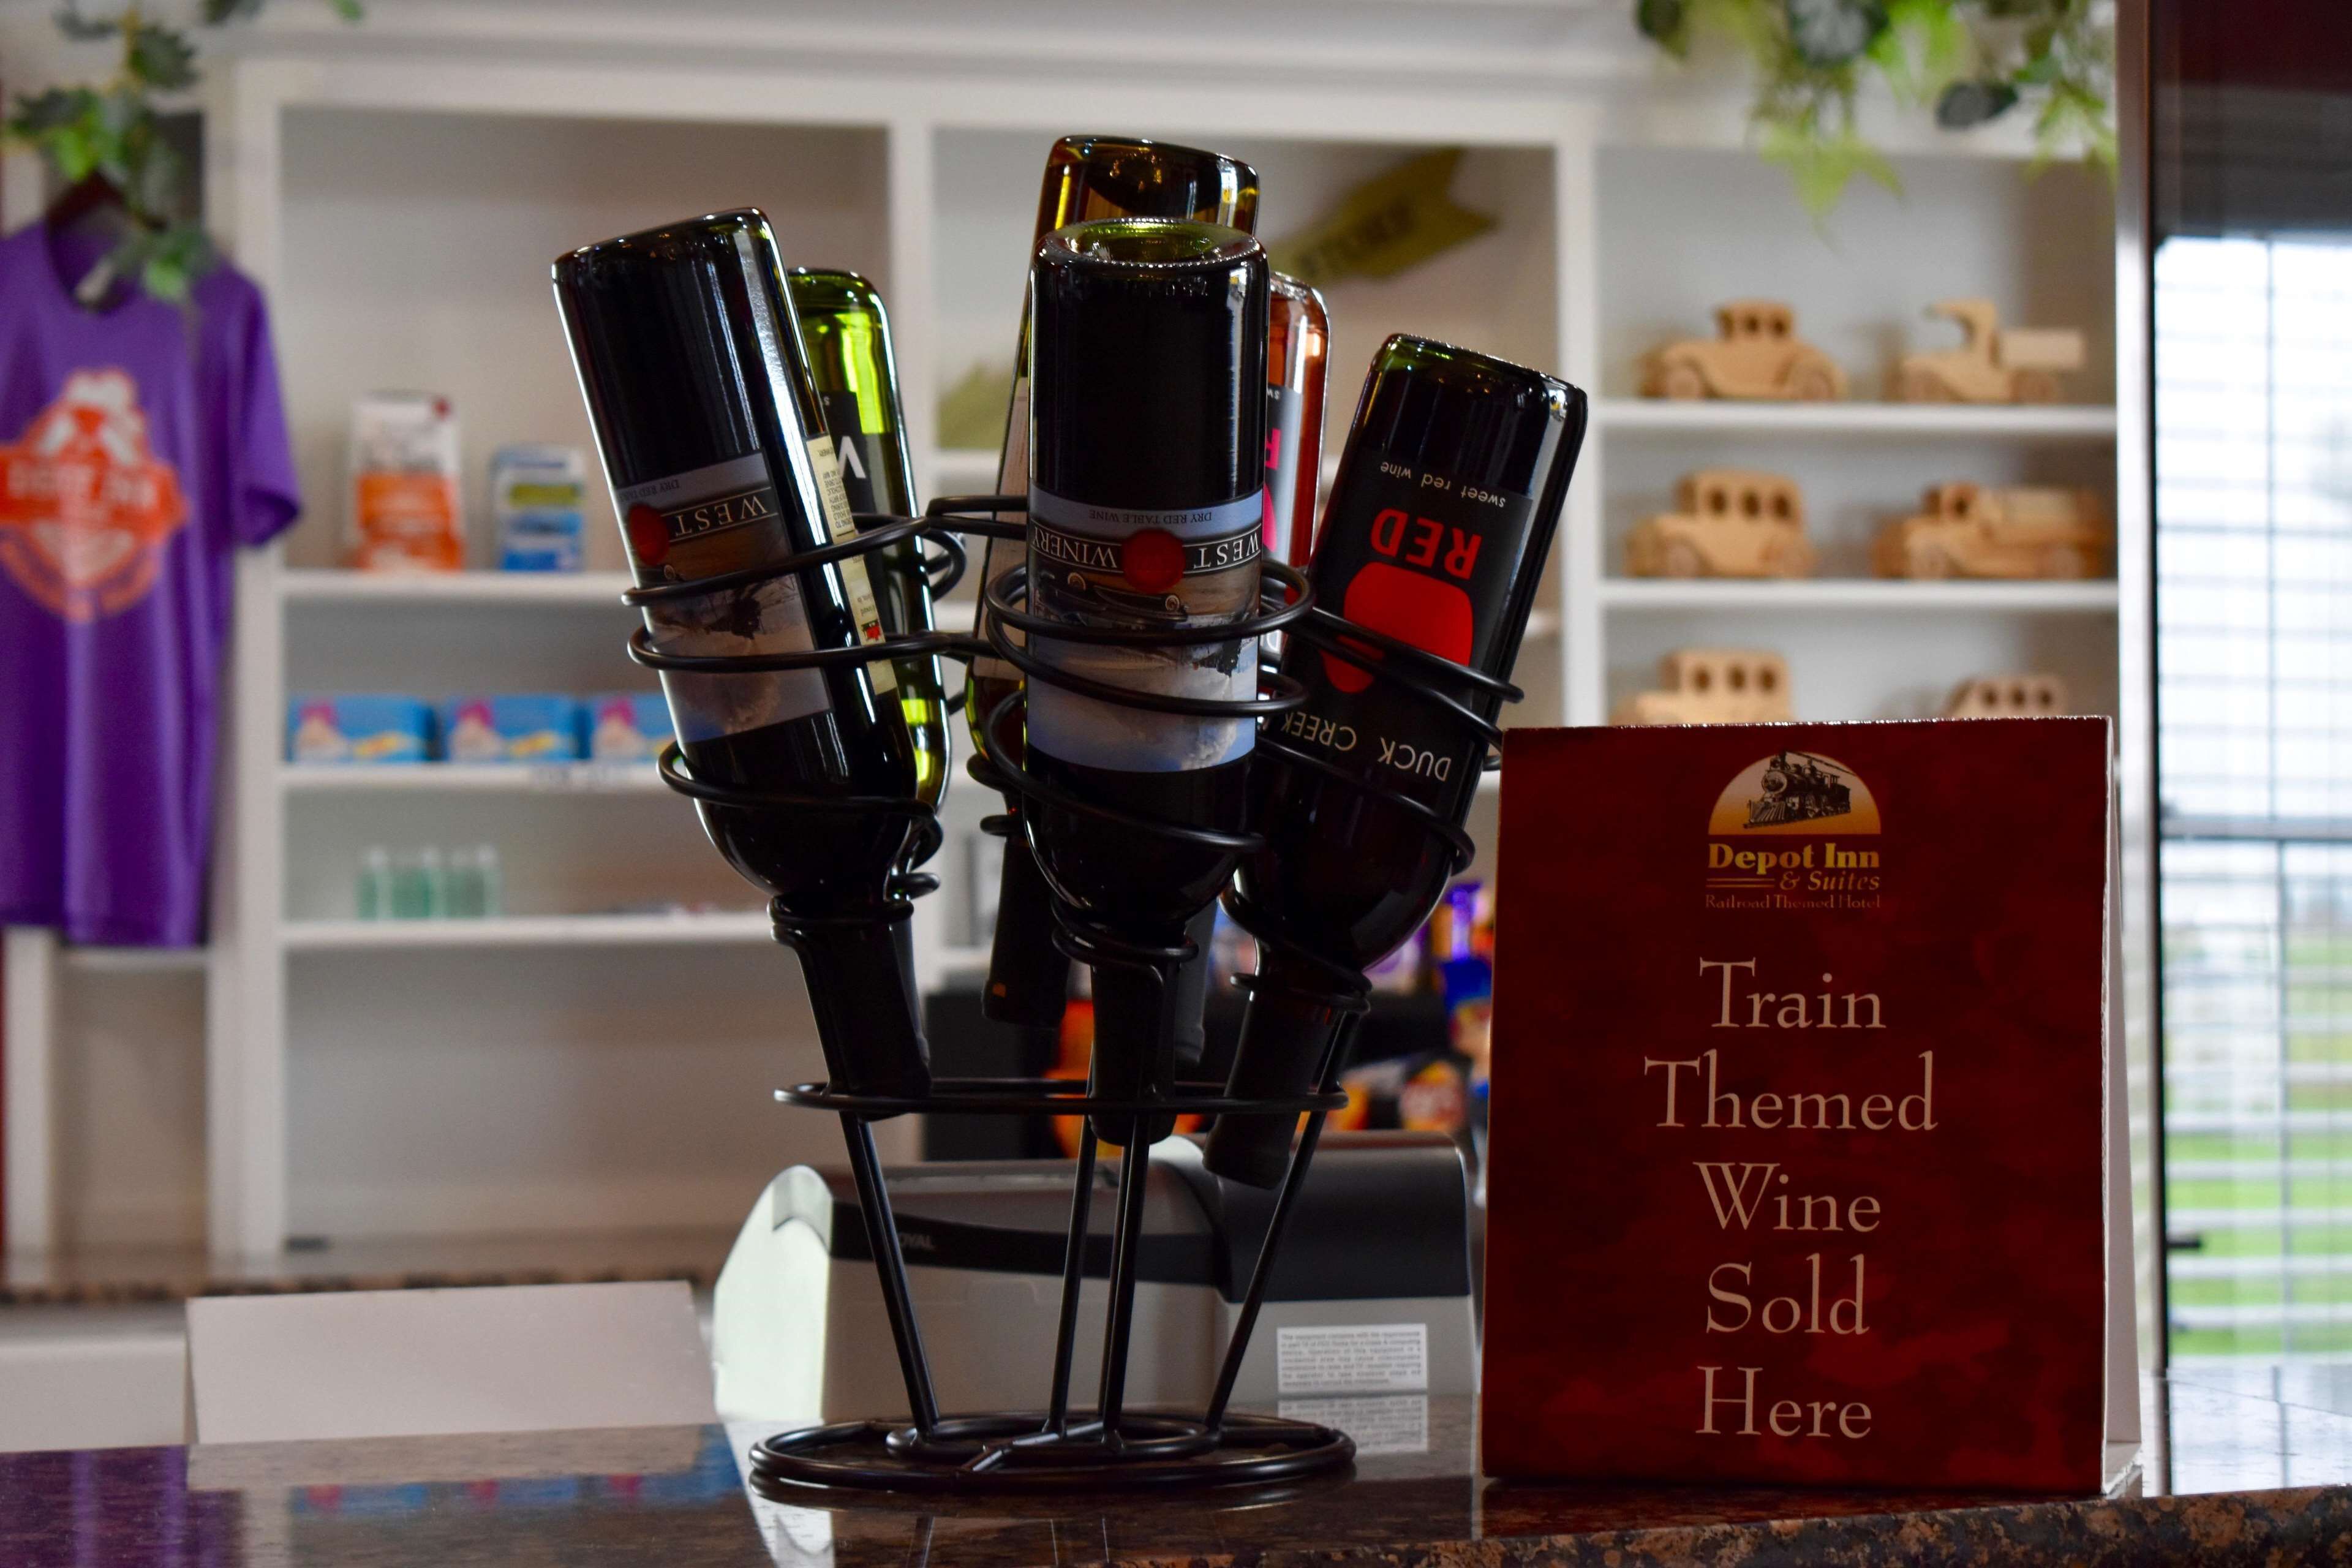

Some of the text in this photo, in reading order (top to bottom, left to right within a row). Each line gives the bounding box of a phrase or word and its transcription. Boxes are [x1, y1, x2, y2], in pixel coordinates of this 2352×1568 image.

[1380, 461, 1506, 508] sweet red wine
[675, 495, 769, 537] WEST
[1088, 509, 1212, 524] DRY RED TABLE WINE
[1371, 508, 1482, 580] RED
[1031, 526, 1262, 570] WEST WINERY
[1280, 711, 1452, 782] DUCK CREEK
[1708, 842, 1880, 875] Depot Inn
[1779, 870, 1880, 891] & Suites
[1705, 894, 1881, 909] Railroad Themed Hotel
[1699, 957, 1887, 1028] Train
[1644, 1048, 1939, 1131] Themed
[1692, 1161, 1881, 1232] Wine
[1706, 1253, 1871, 1335] Sold
[1695, 1365, 1872, 1439] Here
